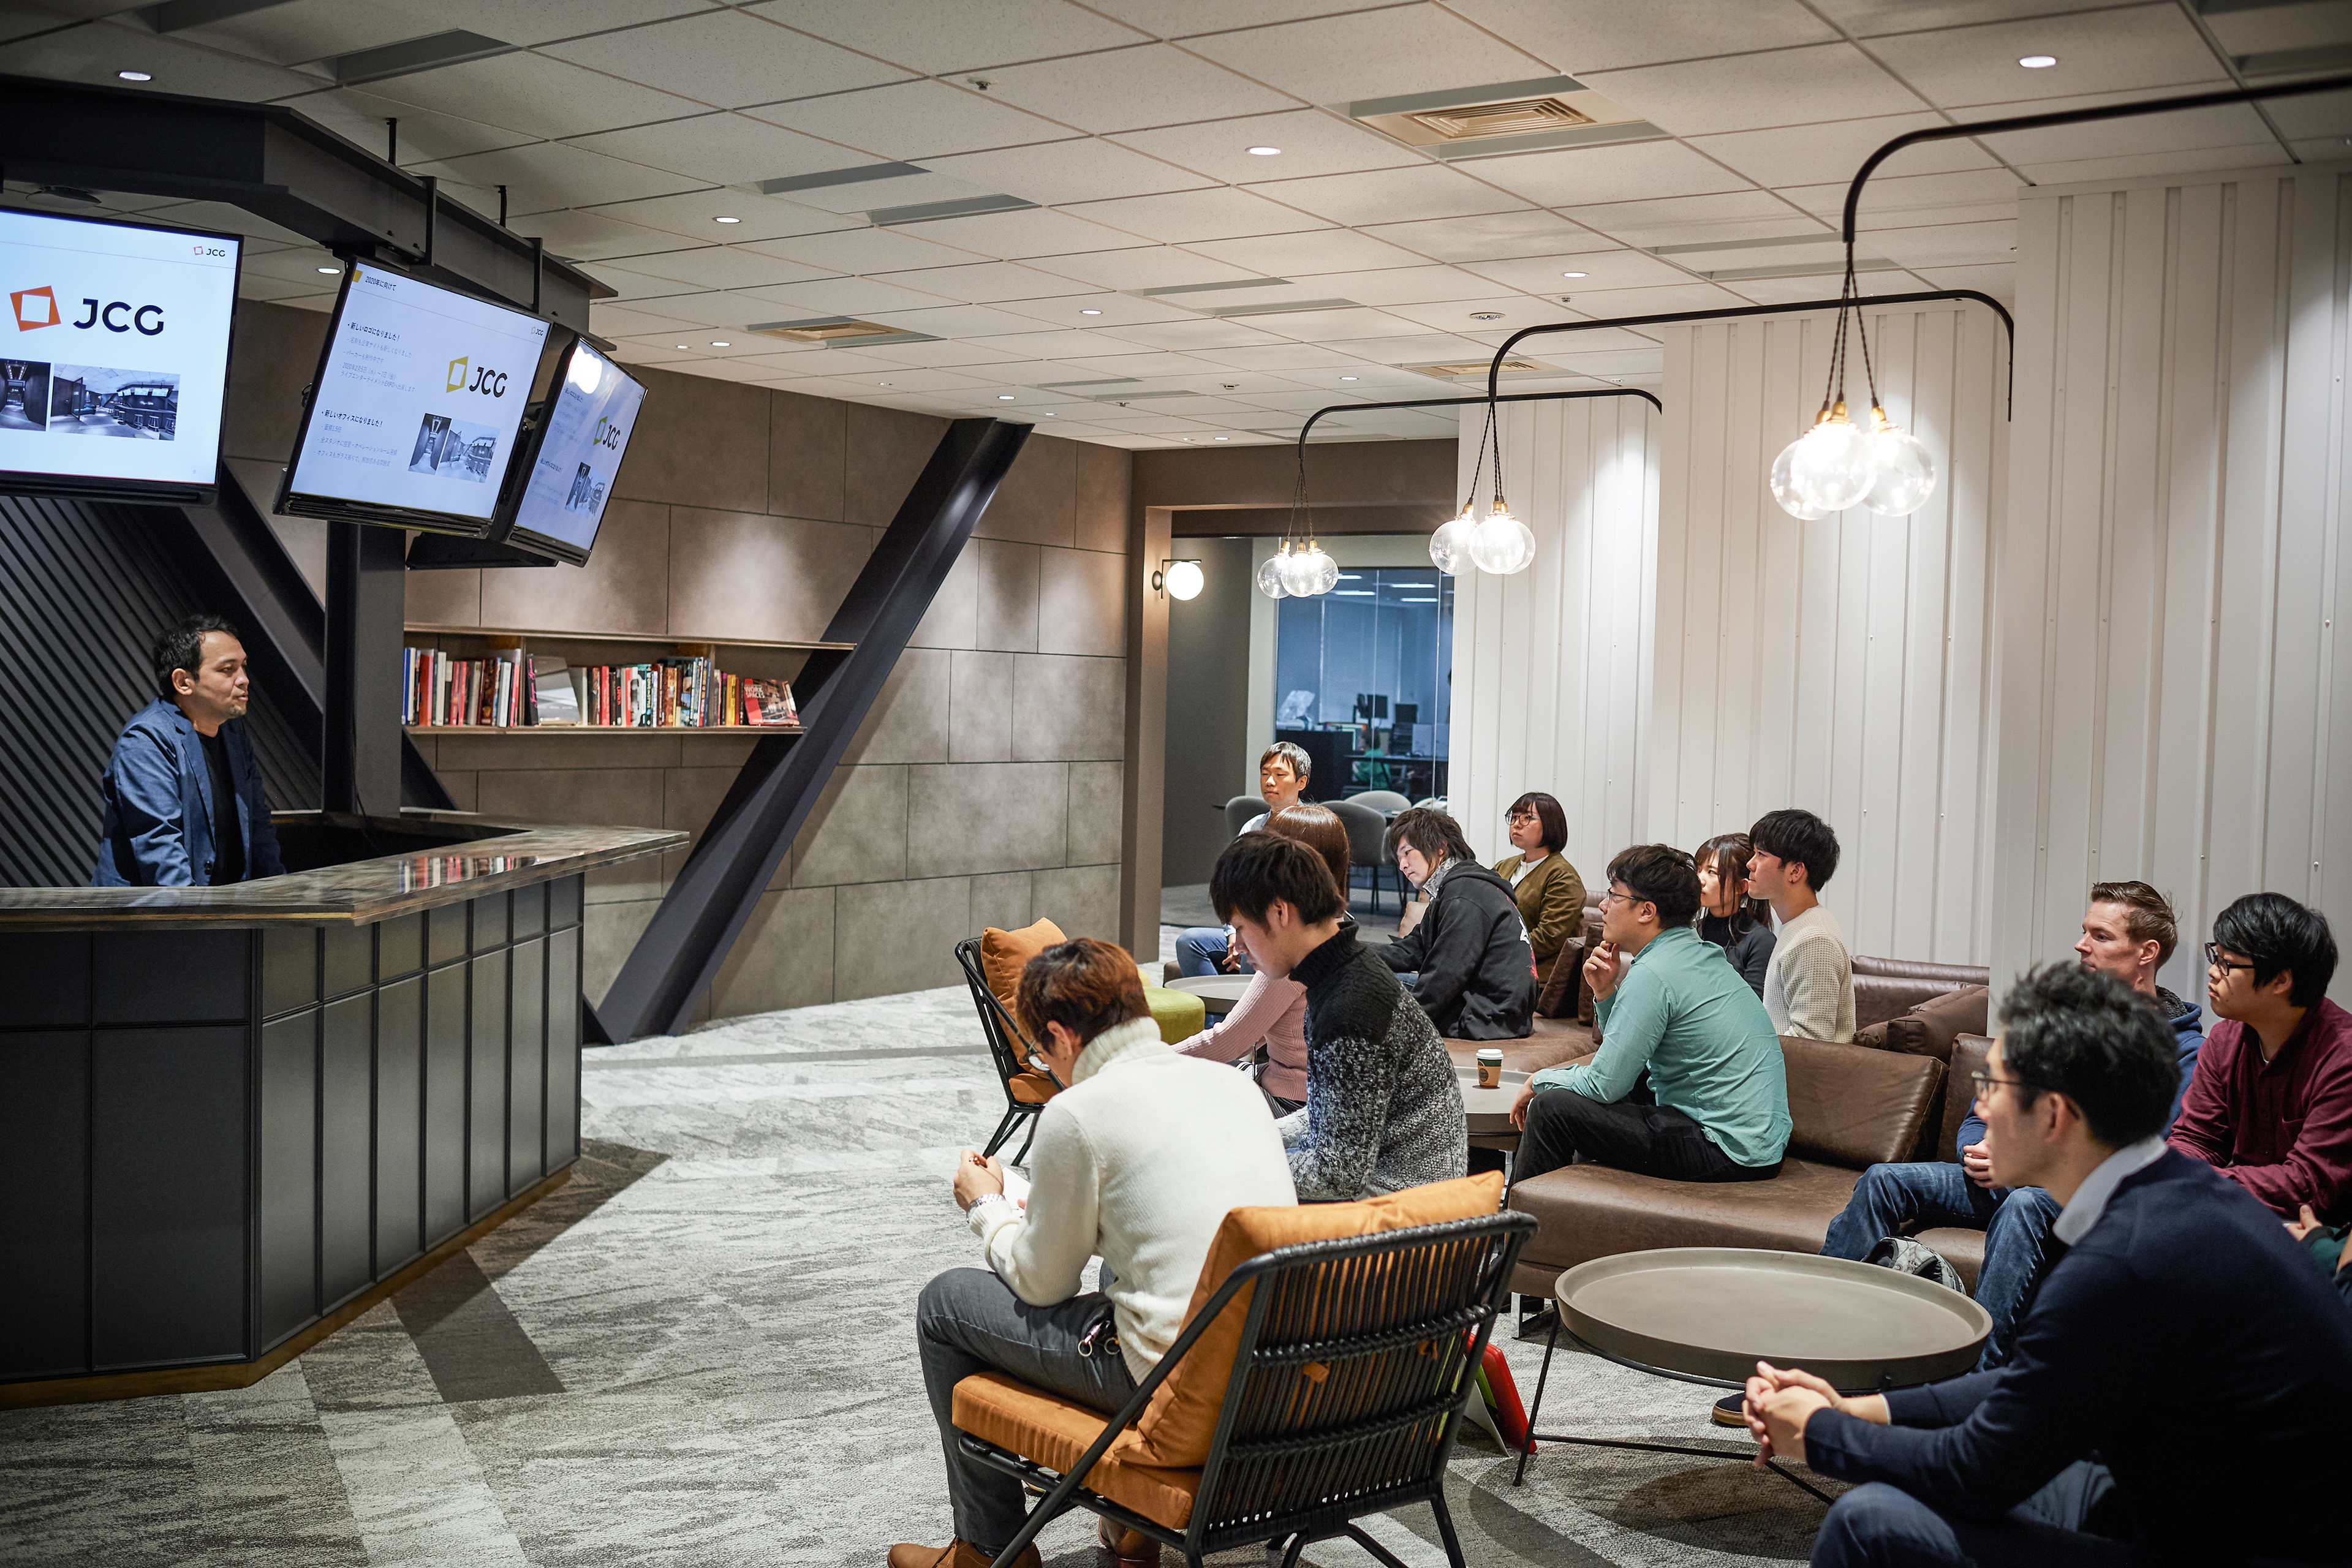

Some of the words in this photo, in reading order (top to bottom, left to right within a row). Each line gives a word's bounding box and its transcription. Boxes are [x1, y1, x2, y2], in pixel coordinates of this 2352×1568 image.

[206, 248, 225, 257] JCG
[366, 276, 397, 291] 2020年に向けて
[73, 298, 165, 336] JCG
[469, 366, 508, 398] JCG
[603, 424, 621, 450] JCG
